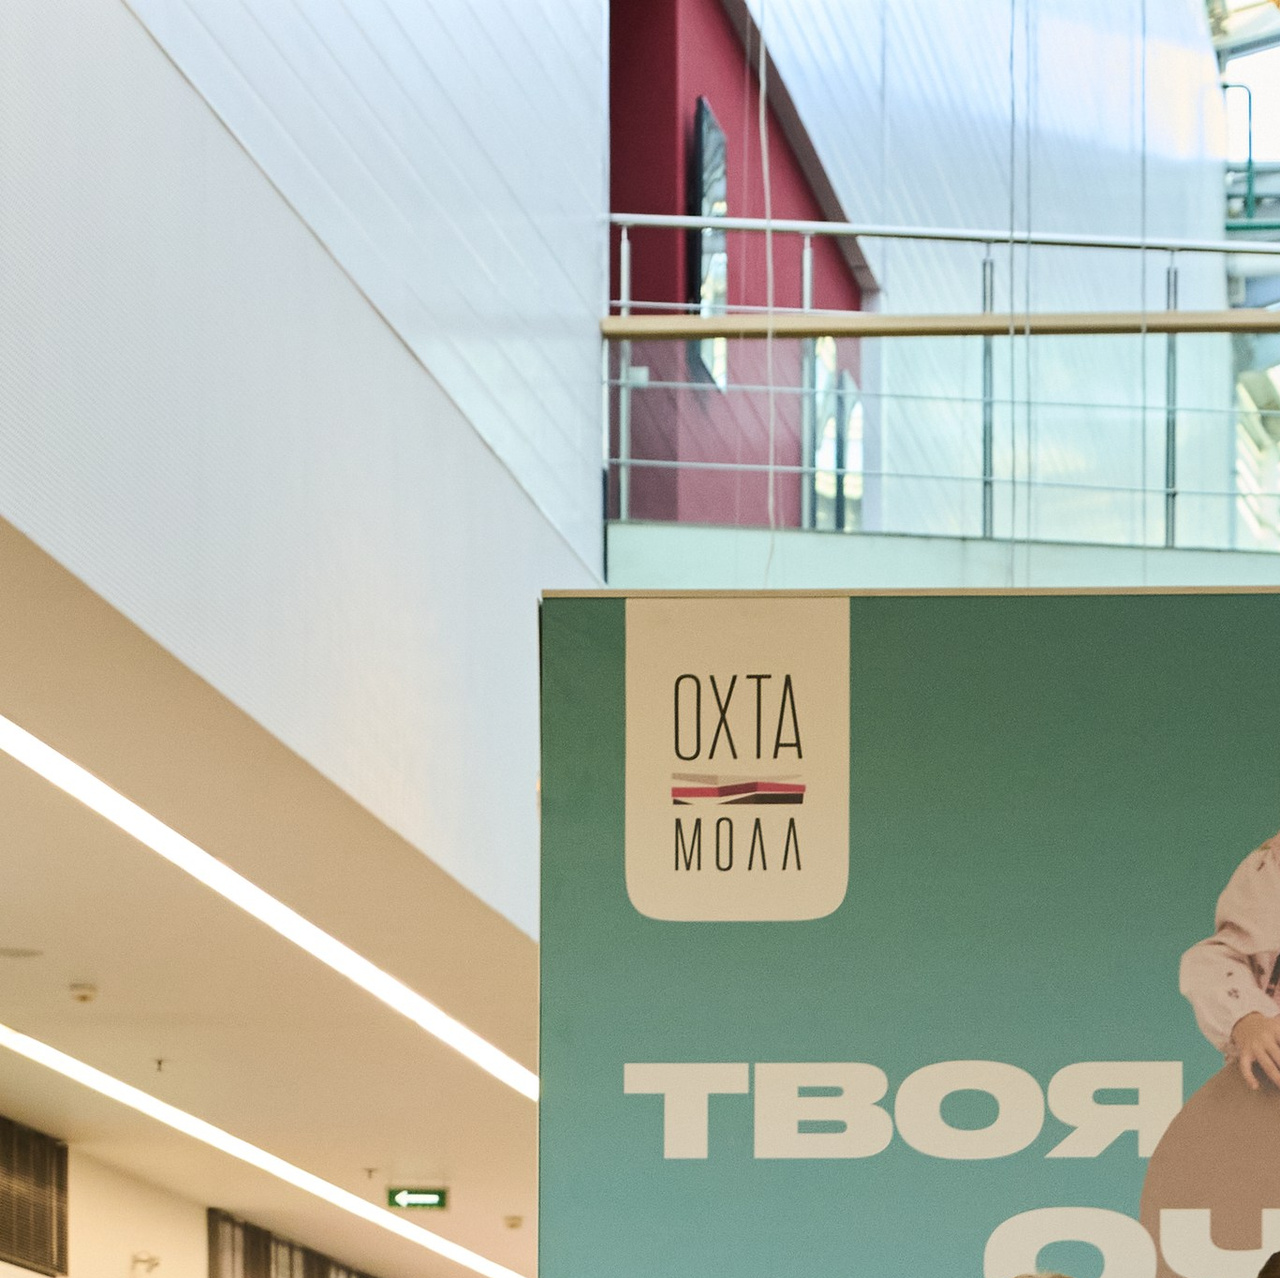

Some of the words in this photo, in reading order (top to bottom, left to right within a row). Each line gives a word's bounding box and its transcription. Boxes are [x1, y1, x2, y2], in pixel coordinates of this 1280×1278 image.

[674, 673, 803, 761] ОХТА
[674, 816, 802, 872] МОЛЛ
[623, 1059, 1184, 1160] ТВОЯ
